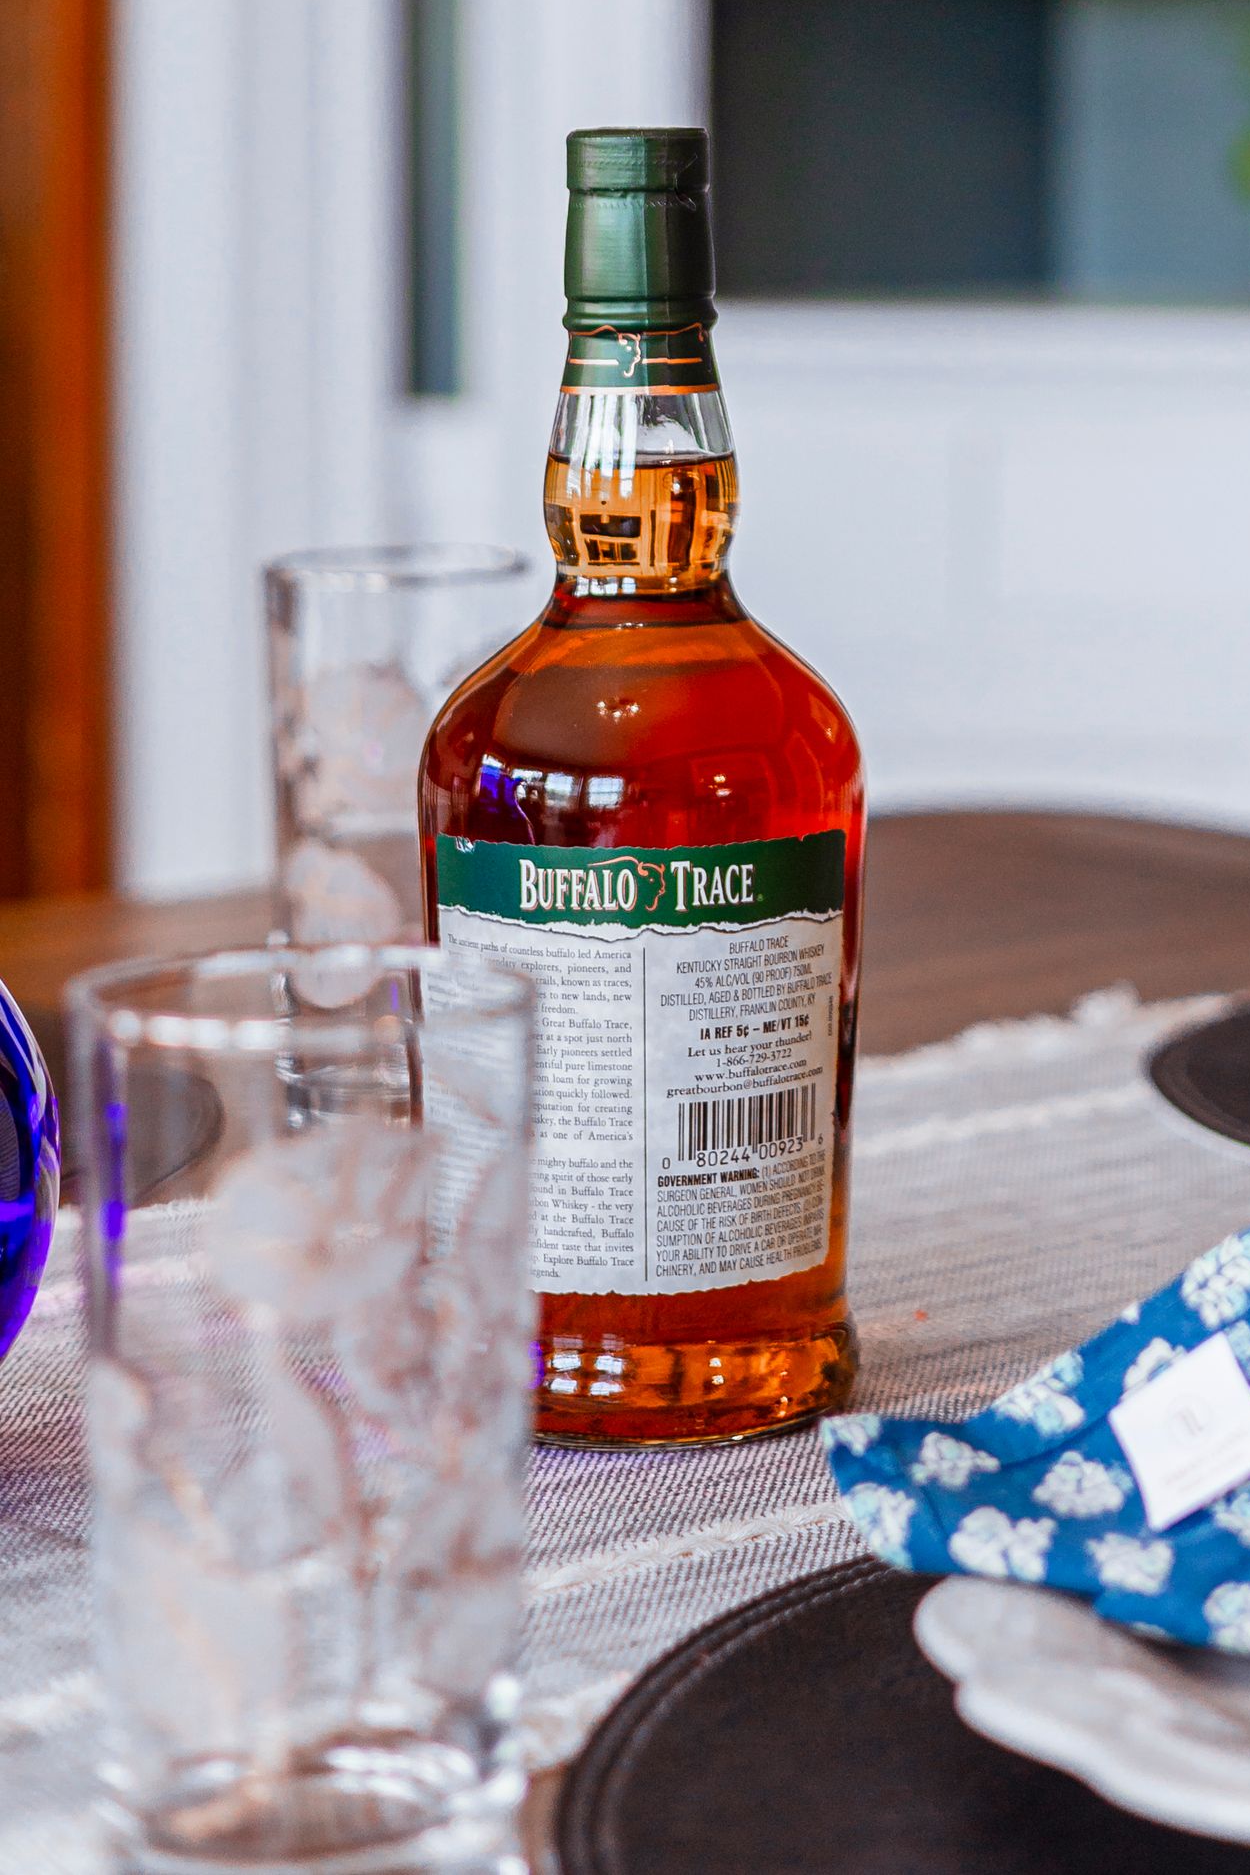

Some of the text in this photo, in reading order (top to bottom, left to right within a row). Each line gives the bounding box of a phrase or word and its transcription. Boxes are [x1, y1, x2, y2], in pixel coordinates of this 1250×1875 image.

[519, 858, 755, 912] BUFFALO TRACE
[480, 940, 498, 952] paths
[500, 942, 508, 953] of
[509, 945, 544, 957] countless
[546, 947, 575, 959] buffalo
[578, 948, 591, 959] led
[594, 949, 632, 959] America
[729, 935, 789, 955] BUFFALO TRACE
[676, 943, 825, 974] KENTUCKY STRAIGHT BOURBON WHISKEY
[521, 960, 562, 974] explorers,
[568, 962, 609, 975] pioneers,
[614, 963, 632, 973] and
[536, 976, 559, 987] trails,
[561, 977, 591, 987] known
[603, 979, 632, 988] traces,
[695, 963, 813, 989] 45% ALC/VOL (90 PROOF) 750ML
[550, 992, 558, 1000] to
[561, 993, 579, 1001] new
[583, 991, 610, 1002] lands,
[660, 972, 833, 1007] DISTILLED, AGED & BOTTLED BY BUFFALO TRACE
[541, 1004, 578, 1015] freedom.
[689, 993, 816, 1021] DISTILLERY, FRANKLIN COUNTY, KY
[542, 1017, 565, 1028] Great
[569, 1018, 601, 1029] Buffalo
[604, 1019, 632, 1030] Trace,
[700, 1014, 810, 1040] IA REF 5¢ ME/VT 15¢
[564, 1034, 583, 1044] spot
[586, 1034, 603, 1044] just
[606, 1034, 632, 1043] north
[688, 1031, 812, 1058] Let us hear your thunder!
[536, 1045, 632, 1058] Early pioneers settled
[716, 1048, 792, 1068] 1-866-729-3722
[565, 1061, 632, 1072] pure limestone
[694, 1059, 807, 1082] www.buffalotrace.com
[553, 1074, 574, 1084] loam
[577, 1074, 590, 1084] for
[594, 1076, 632, 1087] growing
[666, 1066, 823, 1099] greatbourbon@buffalotrace.com
[556, 1088, 588, 1100] quickly
[591, 1088, 632, 1099] followed.
[577, 1103, 632, 1115] for creating
[558, 1116, 633, 1127] the Buffalo Trace
[553, 1132, 568, 1140] one
[573, 1130, 583, 1140] of
[588, 1131, 633, 1141] America's
[696, 1147, 750, 1167] 80244
[758, 1136, 804, 1160] 00923
[817, 1133, 824, 1145] 6
[537, 1157, 566, 1169] mighty
[568, 1158, 599, 1169] buffalo
[600, 1158, 617, 1169] and
[619, 1159, 633, 1169] the
[552, 1172, 573, 1183] spirit
[576, 1172, 585, 1182] of
[587, 1172, 609, 1182] those
[612, 1173, 633, 1184] early
[657, 1172, 717, 1188] GOVERNMENT
[720, 1168, 760, 1183] WARNING:
[761, 1165, 771, 1178] (1)
[772, 1156, 809, 1175] ACCORDING
[558, 1185, 634, 1196] in Buffalo Trace
[657, 1170, 811, 1203] SURGEON GENERAL, WOMEN SHOULD NOT
[552, 1198, 588, 1212] Whiskey
[598, 1201, 612, 1210] the
[615, 1204, 634, 1213] very
[657, 1183, 817, 1218] ALCOHOLIC BEVERAGES DURING PREGNANCY
[540, 1213, 548, 1221] at
[553, 1213, 566, 1222] the
[571, 1214, 604, 1224] Buffalo
[608, 1215, 634, 1224] Trace
[657, 1210, 772, 1233] CAUSE OF THE RISK OF BIRTH
[544, 1225, 596, 1239] handcrafted,
[601, 1228, 634, 1238] Buffalo
[657, 1217, 802, 1247] SUMPTION OF ALCOHOLIC BEVERAGES
[562, 1242, 634, 1252] taste that invites
[656, 1229, 813, 1262] YOUR ABILITY TO DRIVE A CAR OR OPERATE
[543, 1253, 574, 1266] Explore
[576, 1255, 608, 1266] Buffalo
[610, 1256, 634, 1266] Trace
[656, 1249, 792, 1277] CHINERY, AND MAY CAUSE HEALTH
